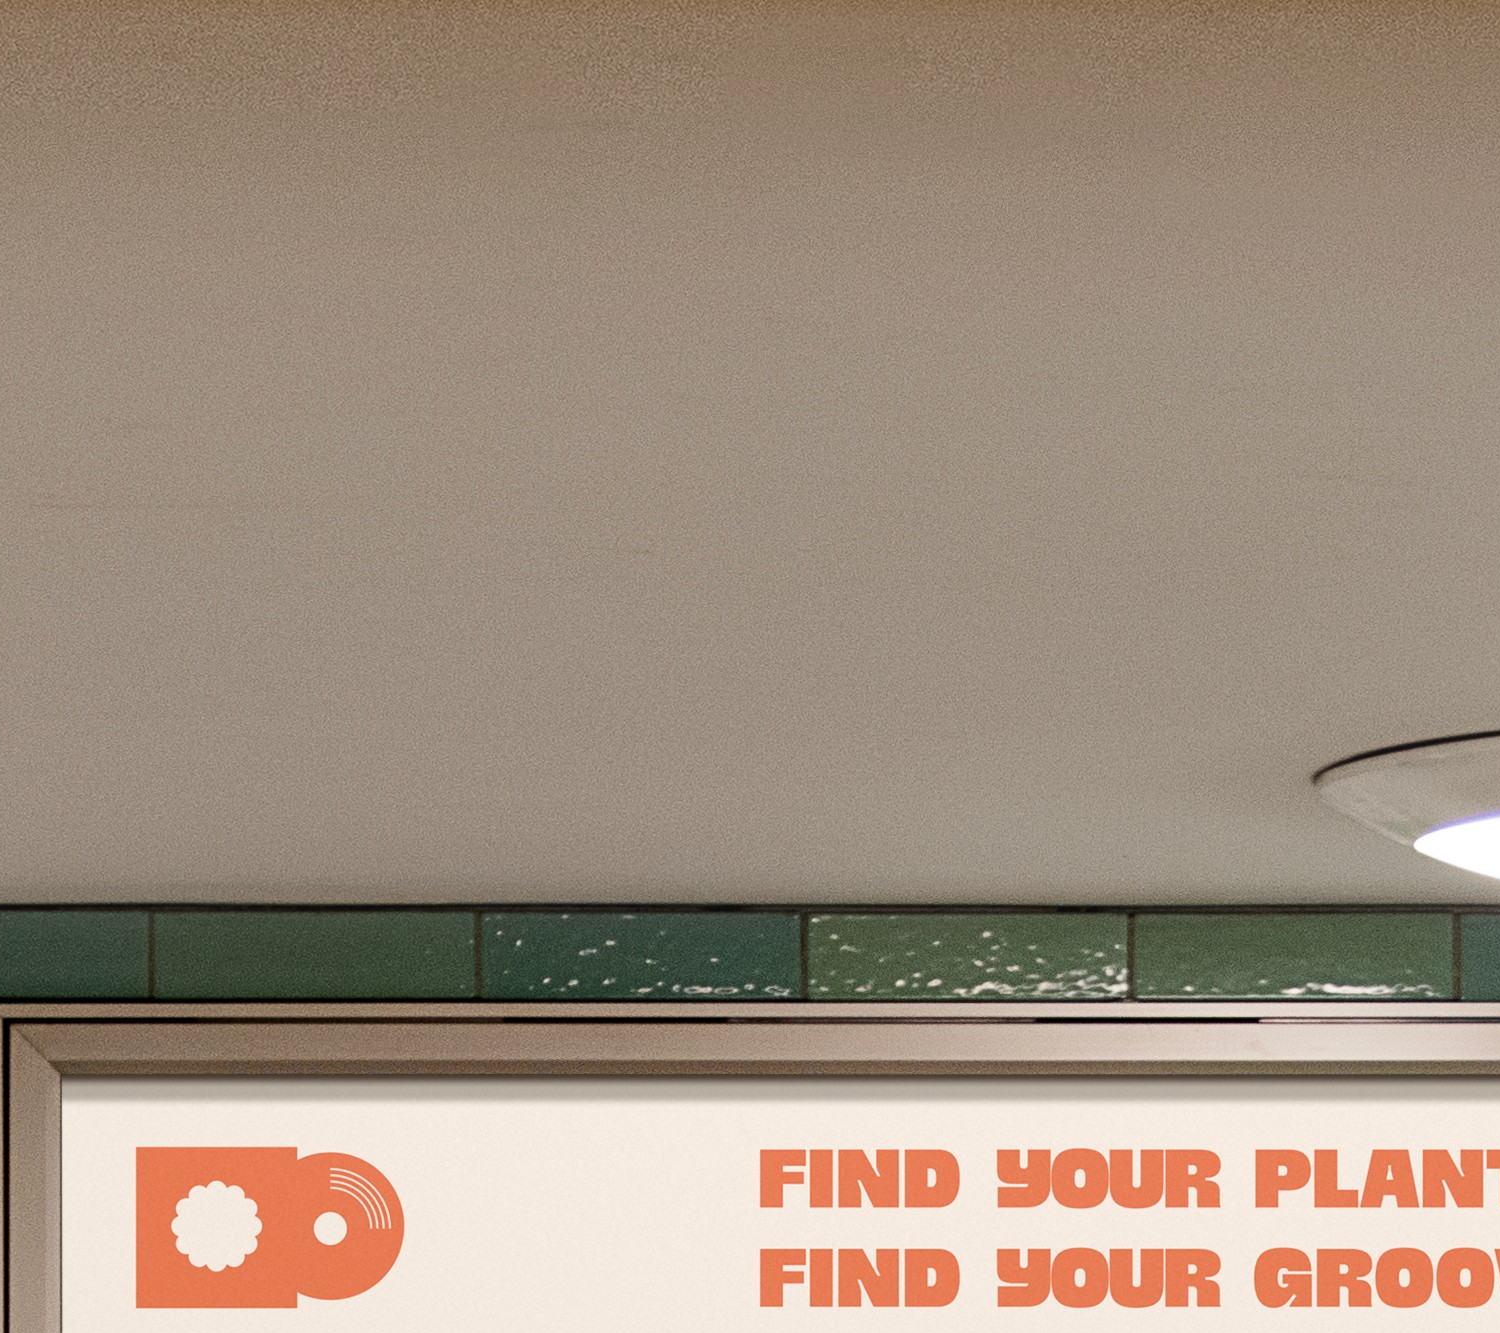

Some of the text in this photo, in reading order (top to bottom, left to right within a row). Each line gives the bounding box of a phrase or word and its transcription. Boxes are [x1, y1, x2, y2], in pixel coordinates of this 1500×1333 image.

[760, 1149, 960, 1209] FIND
[997, 1148, 1221, 1209] YOUR
[760, 1248, 960, 1308] FIND
[997, 1248, 1221, 1308] YOUR
